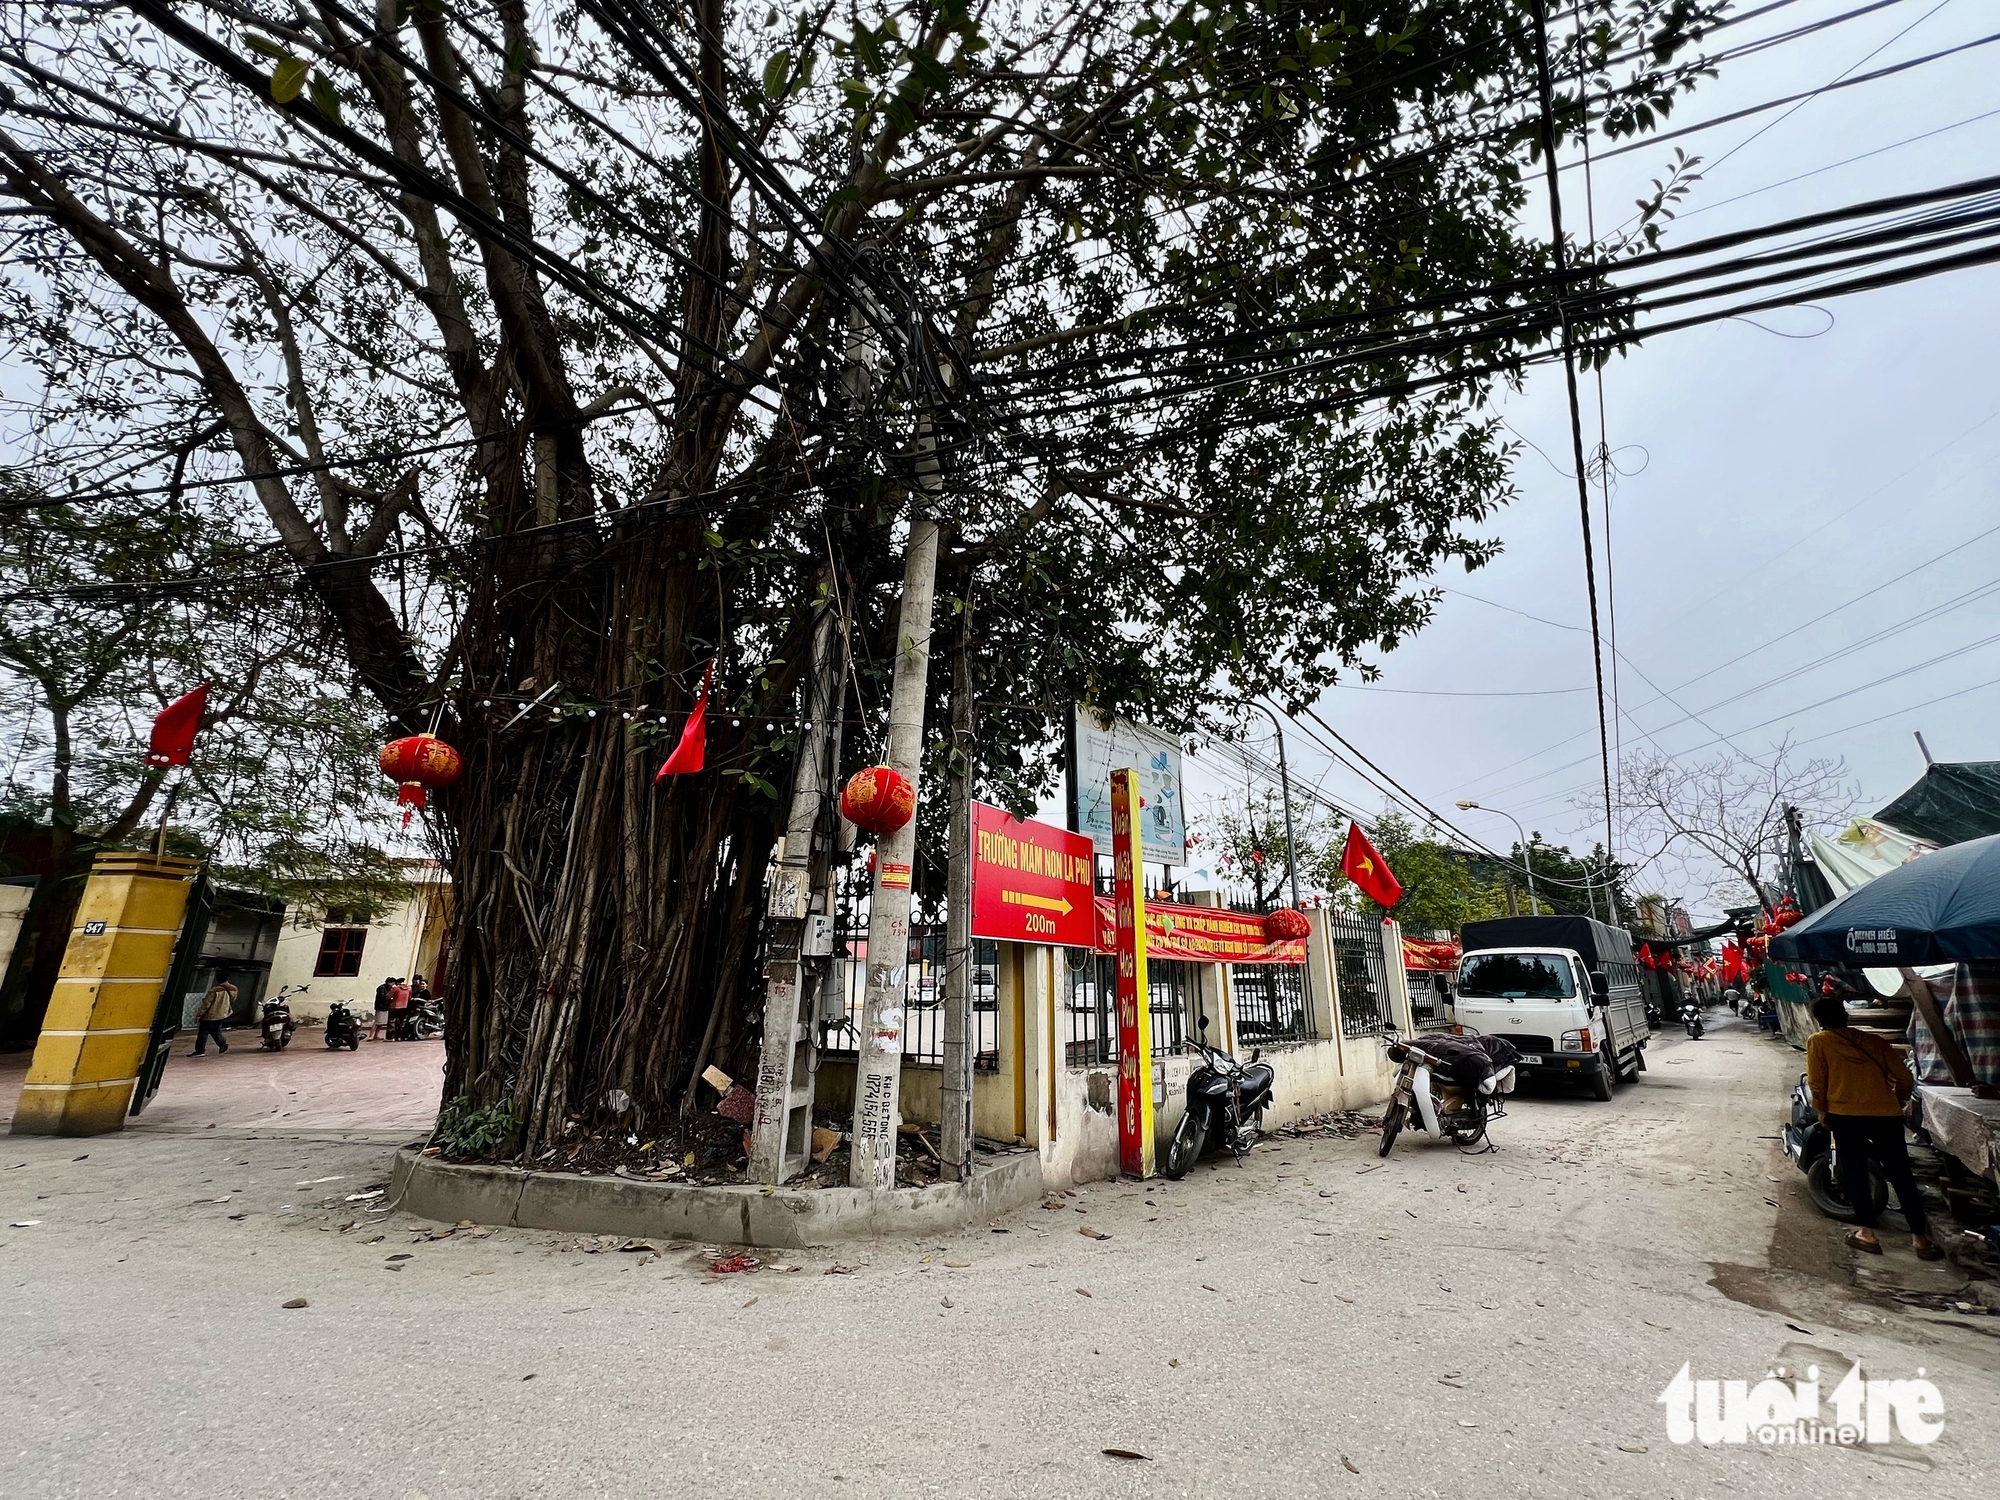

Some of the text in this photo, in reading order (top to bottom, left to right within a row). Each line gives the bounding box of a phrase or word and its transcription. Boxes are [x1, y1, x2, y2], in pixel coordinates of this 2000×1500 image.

[1113, 805, 1129, 835] Xuân
[978, 828, 1090, 886] TRƯỜNG MẦM NON LA PHÙ
[85, 923, 104, 933] 547
[1025, 912, 1056, 934] 200m
[1120, 948, 1133, 978] Hoa
[1122, 993, 1134, 1028] Phú
[1123, 1044, 1136, 1087] Quý
